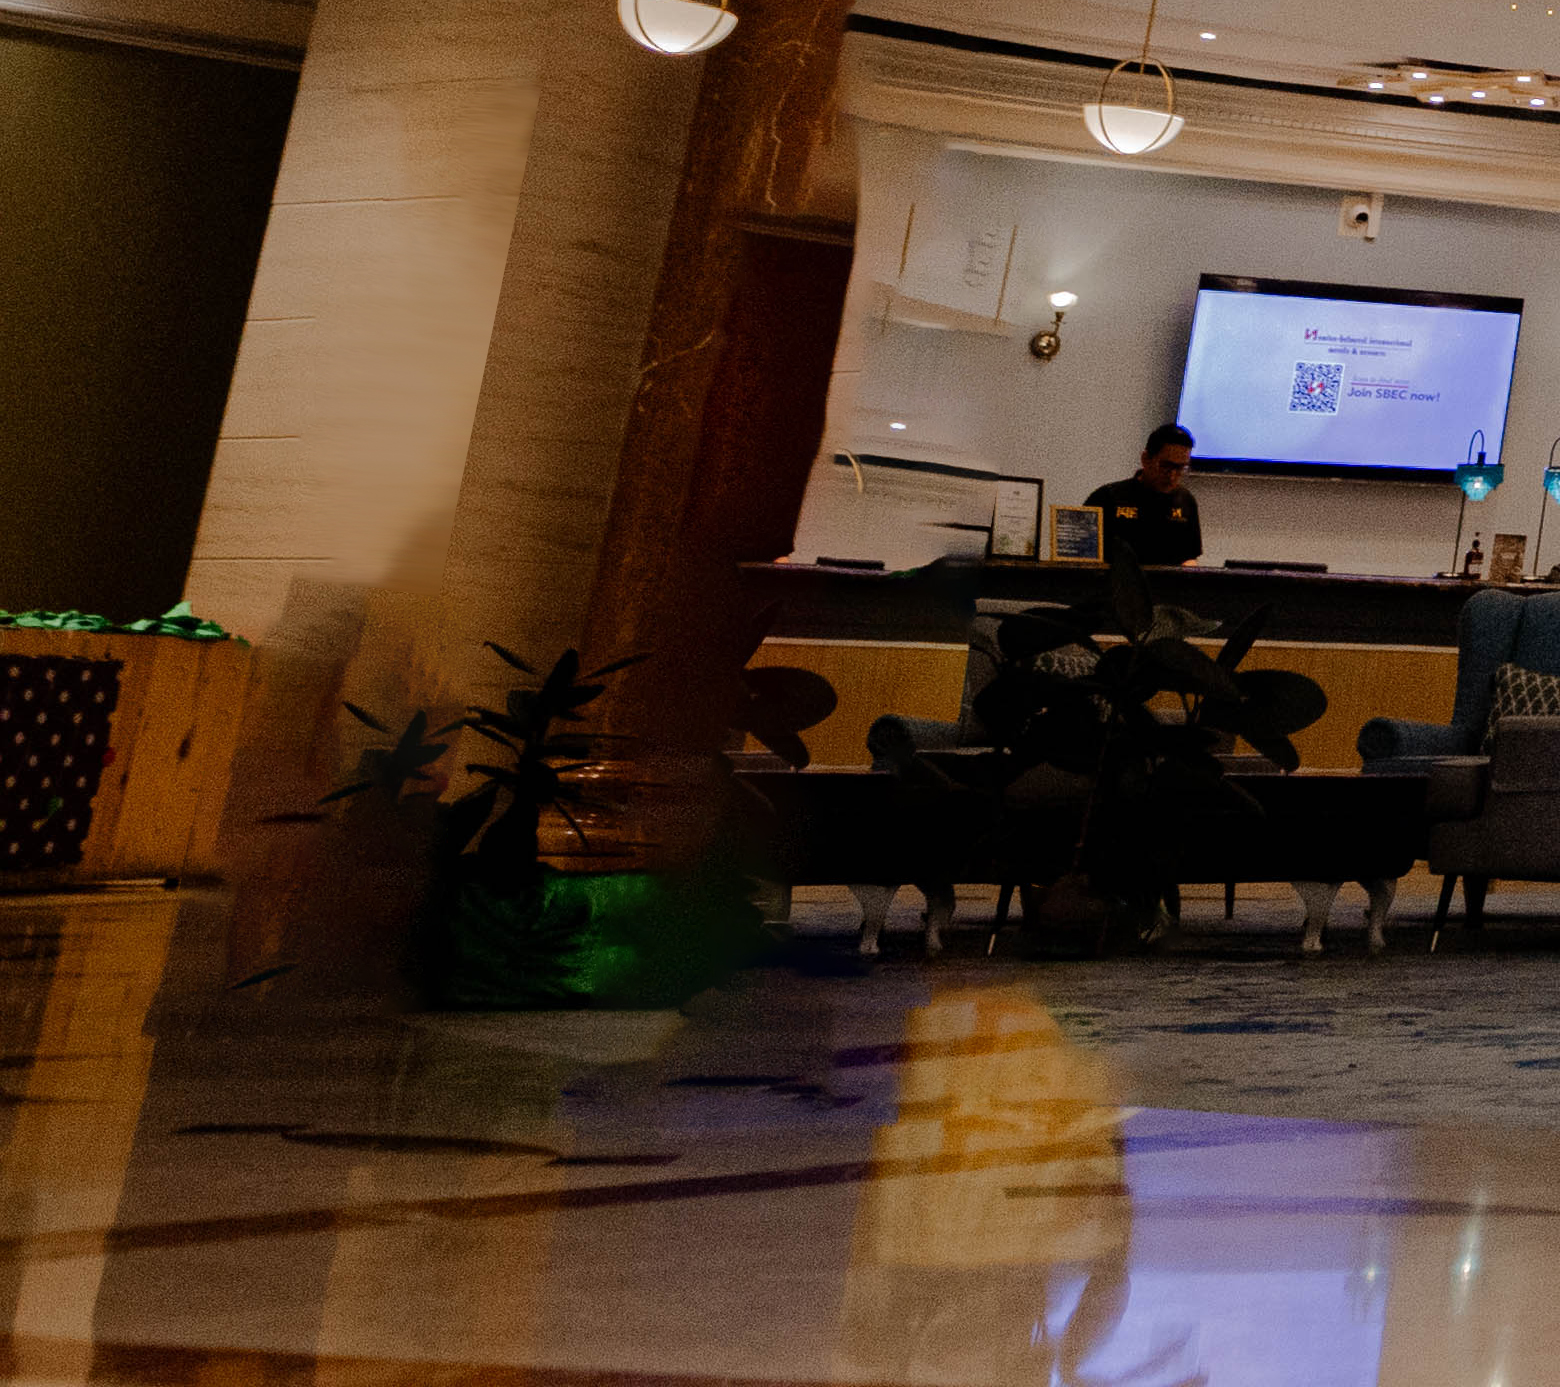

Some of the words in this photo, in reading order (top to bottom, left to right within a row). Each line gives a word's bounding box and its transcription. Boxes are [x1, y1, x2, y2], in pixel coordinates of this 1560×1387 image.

[1347, 387, 1372, 399] Join
[1376, 388, 1408, 401] SBEC
[1410, 391, 1441, 403] now!
